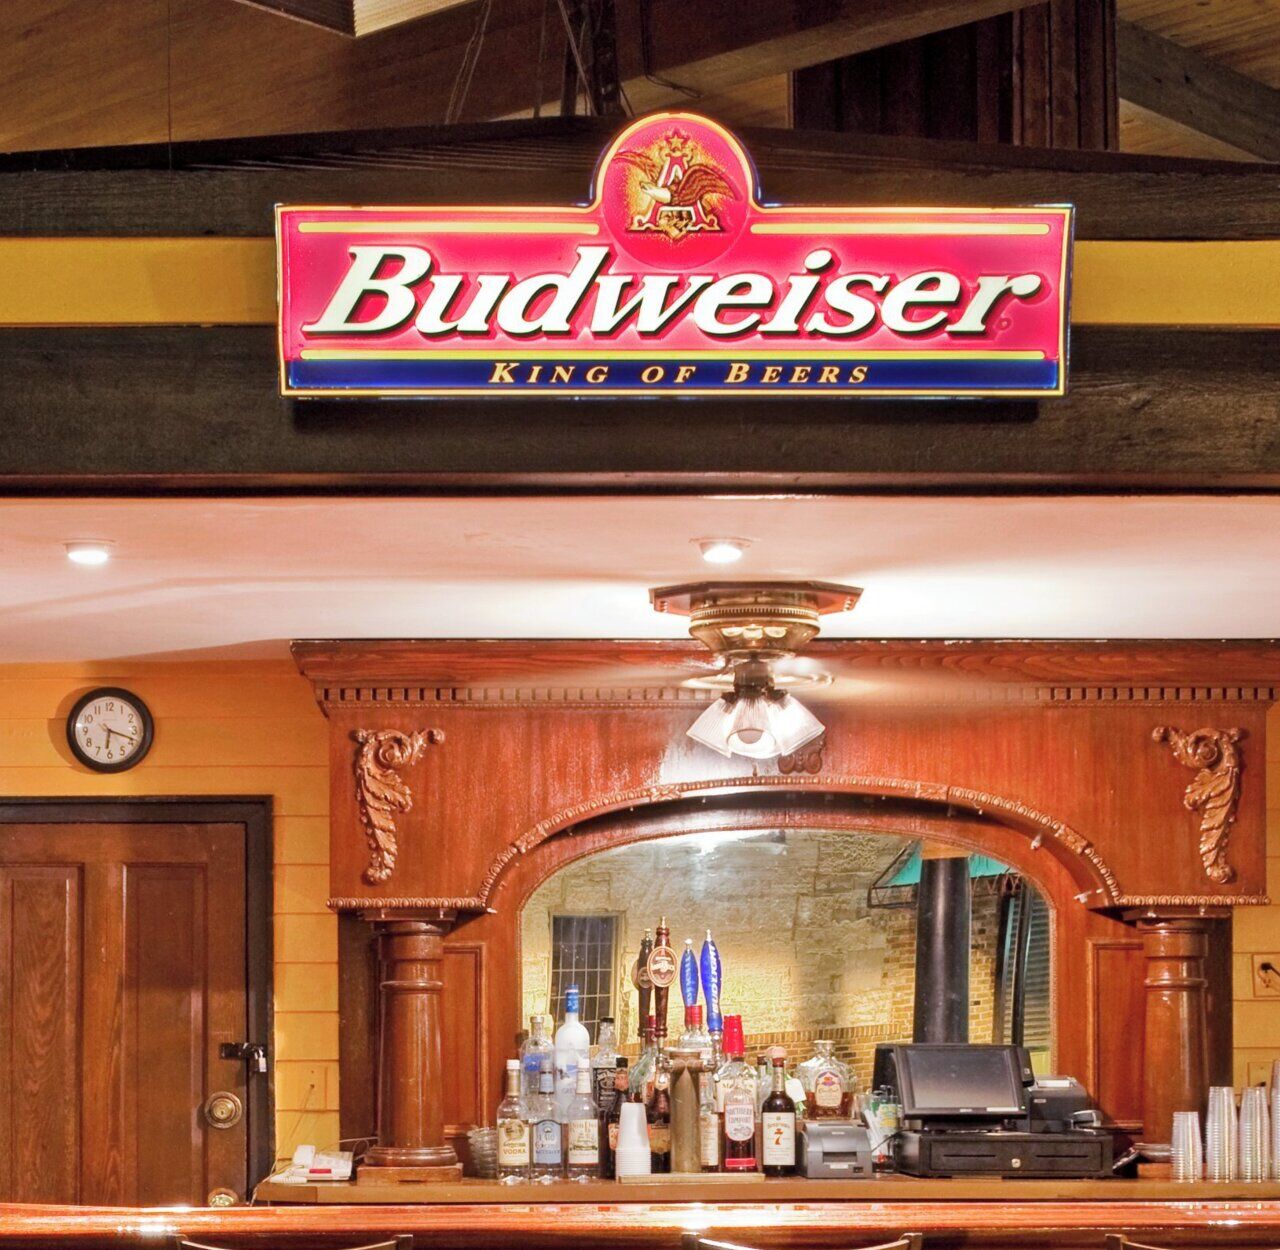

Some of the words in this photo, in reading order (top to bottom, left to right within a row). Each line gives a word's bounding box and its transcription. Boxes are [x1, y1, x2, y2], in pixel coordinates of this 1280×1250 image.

[301, 244, 1044, 337] Budweiser
[488, 361, 610, 385] KING
[640, 363, 697, 385] OF
[724, 361, 872, 385] BEERS
[94, 705, 101, 715] 11
[105, 702, 114, 712] 12
[84, 714, 93, 724] 10
[127, 713, 134, 723] 2
[82, 726, 89, 736] 9
[131, 725, 138, 736] 3
[86, 738, 92, 748] 8
[95, 746, 101, 757] 7
[106, 749, 113, 760] 6
[120, 746, 126, 756] 5
